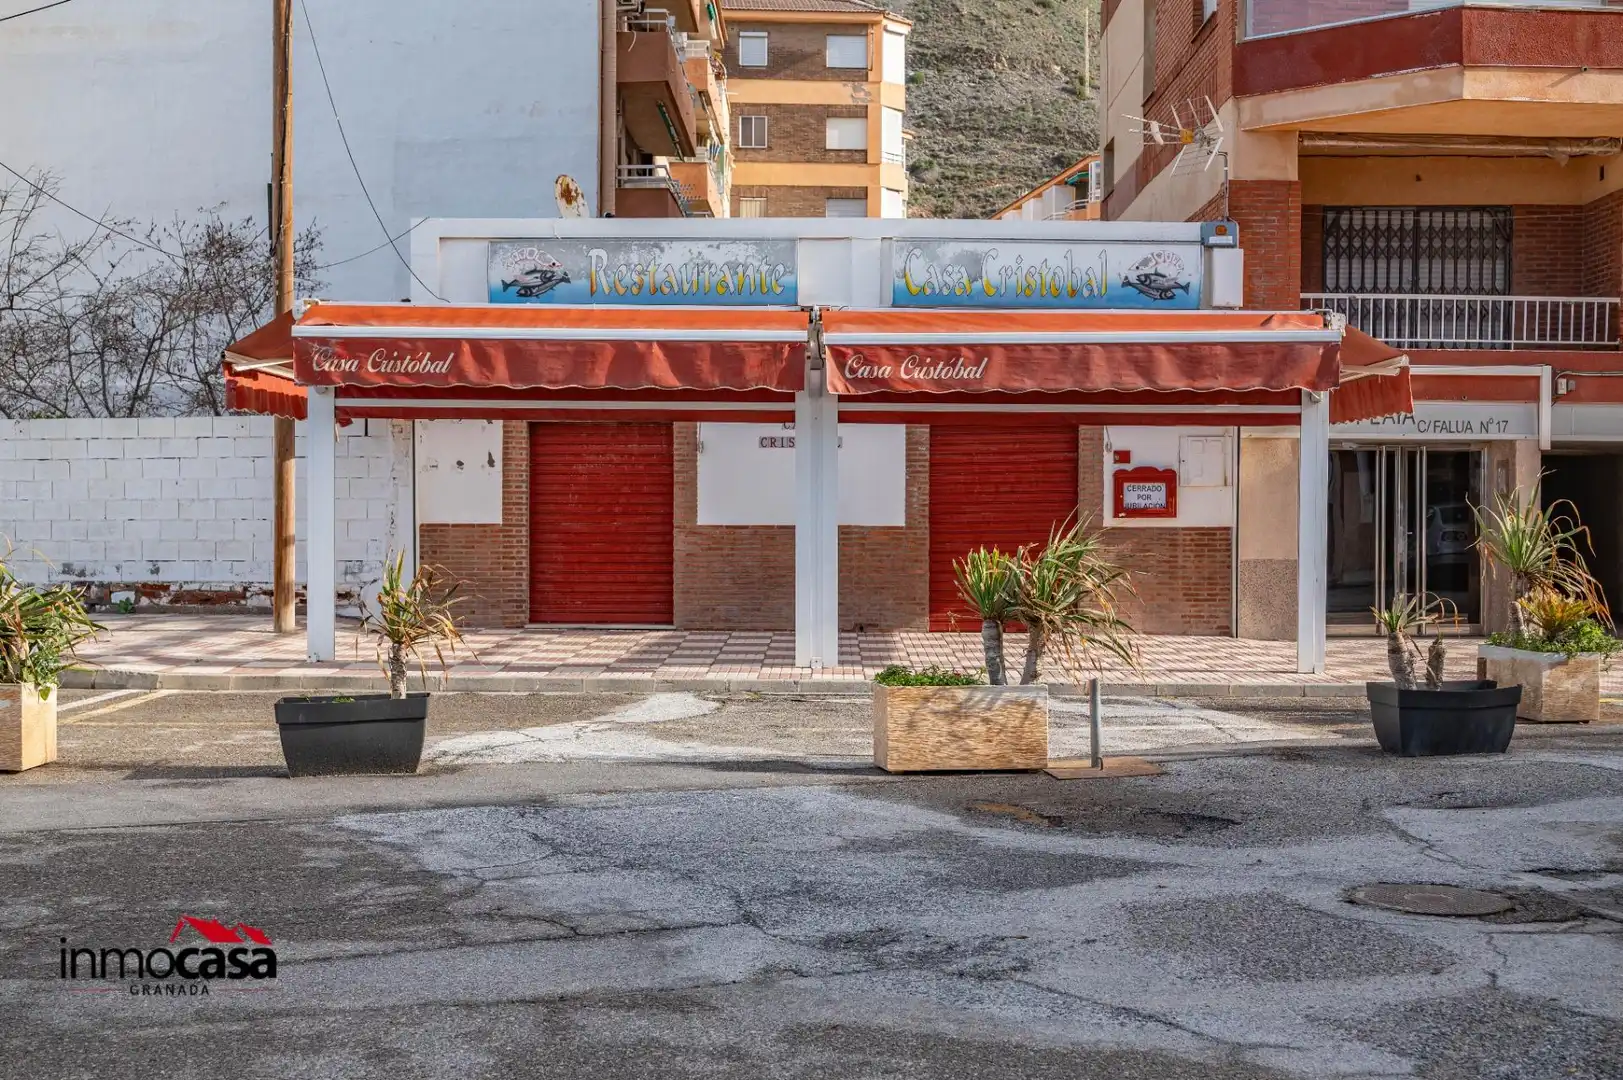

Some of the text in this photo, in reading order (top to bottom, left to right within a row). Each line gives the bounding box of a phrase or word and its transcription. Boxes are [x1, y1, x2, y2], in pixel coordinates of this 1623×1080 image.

[587, 248, 785, 297] Restaurante
[904, 247, 1107, 298] Casa Cristobal
[312, 346, 454, 374] Casa Cristóbal
[844, 354, 988, 380] Casa Cristóbal
